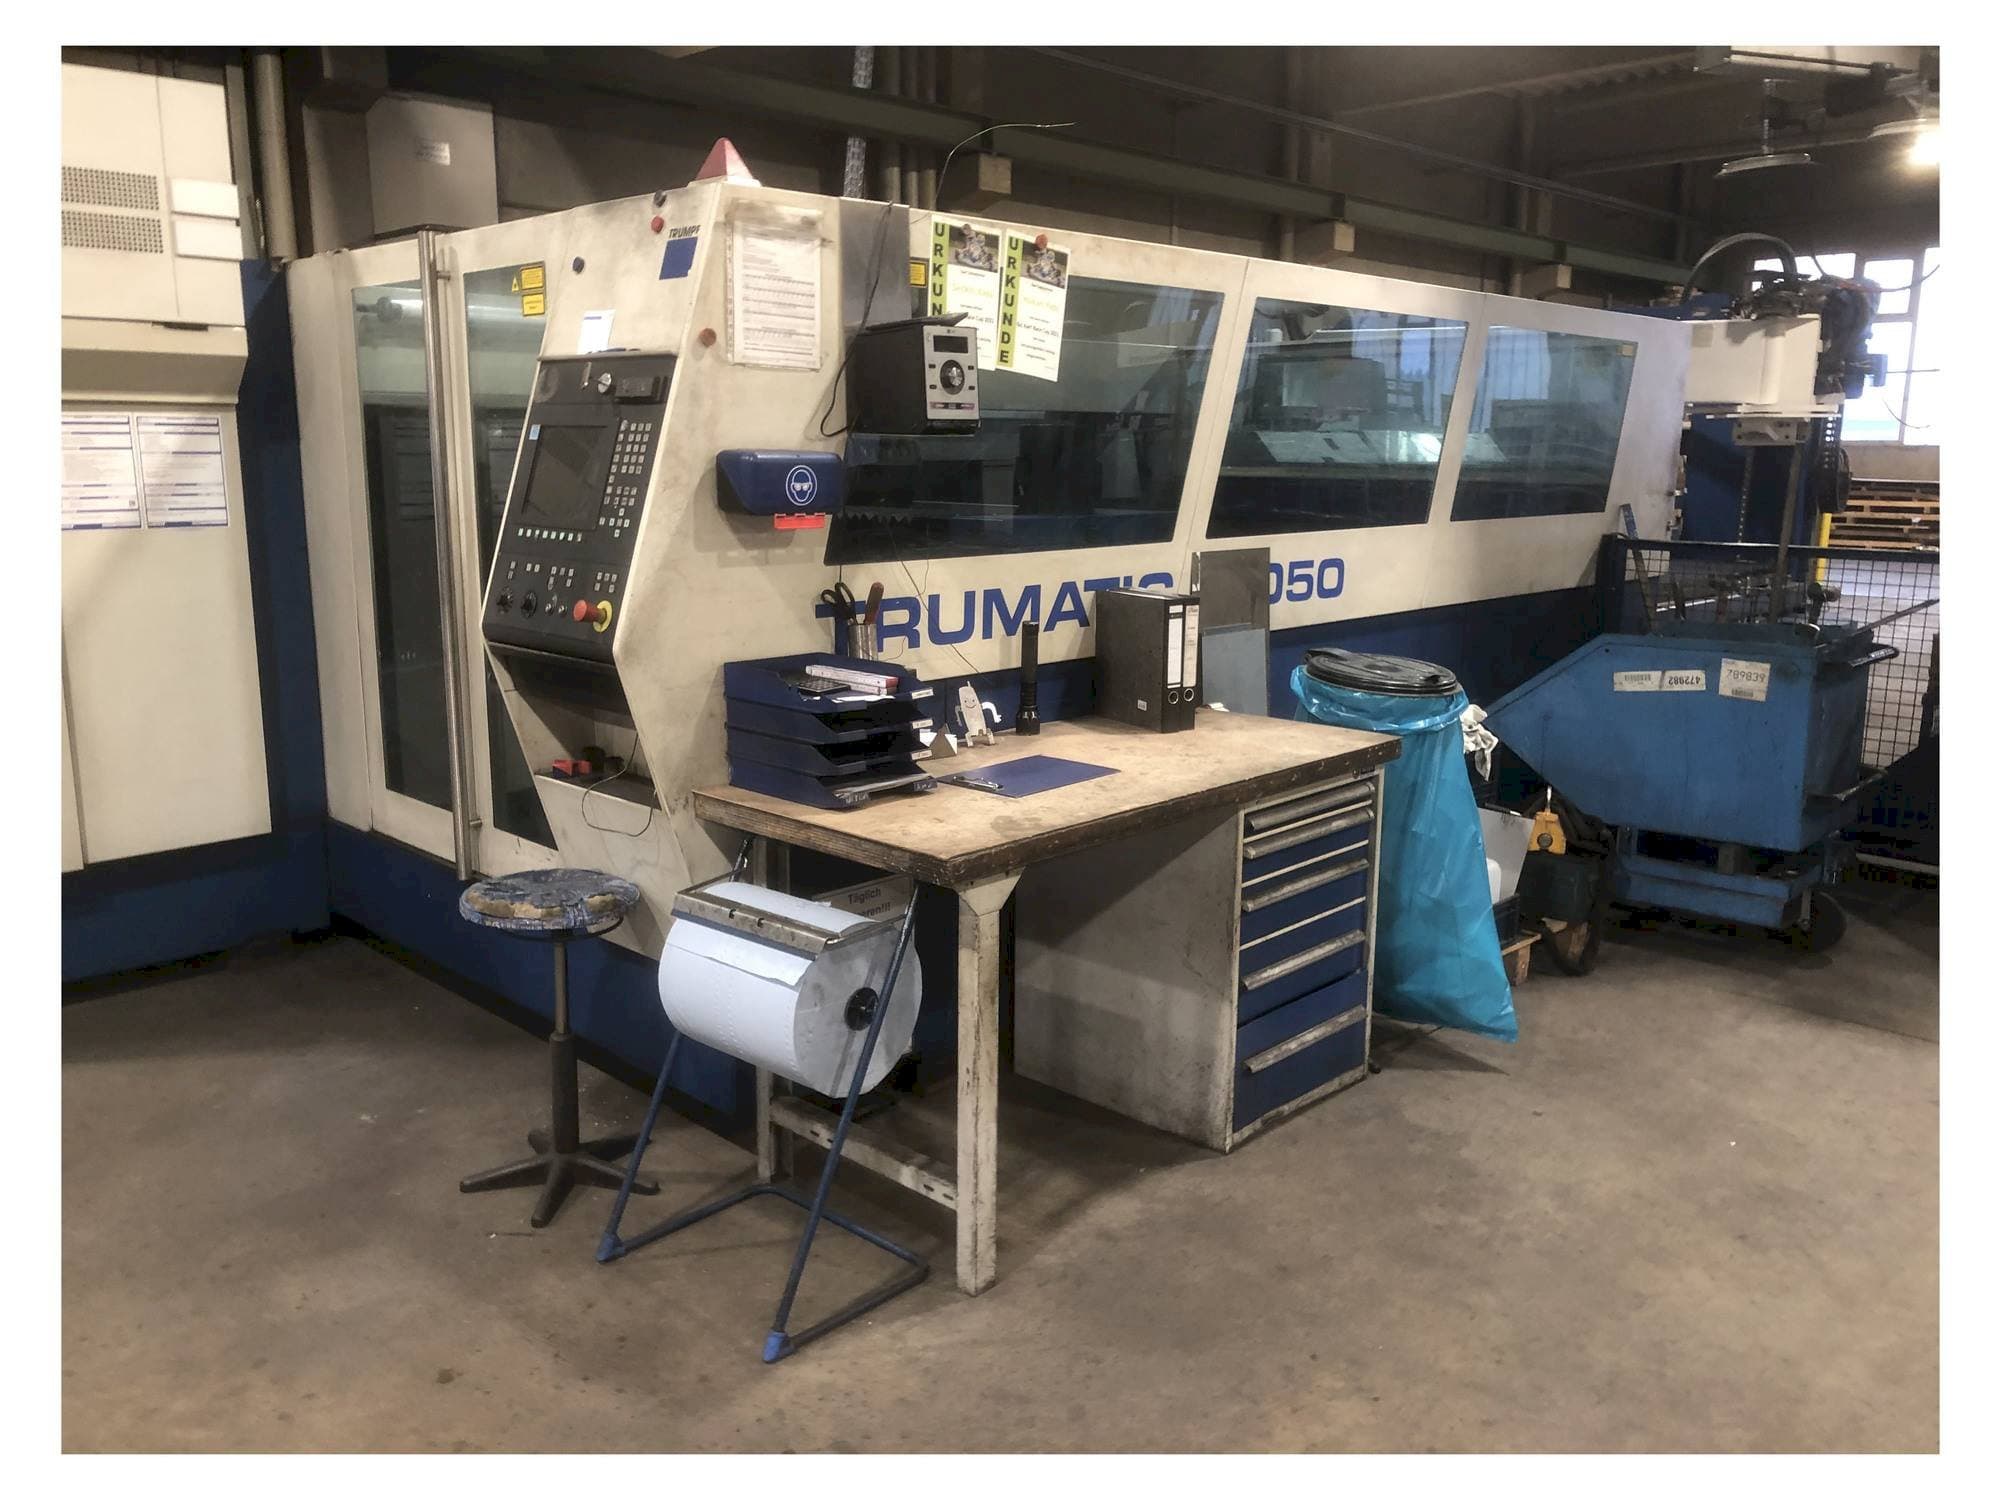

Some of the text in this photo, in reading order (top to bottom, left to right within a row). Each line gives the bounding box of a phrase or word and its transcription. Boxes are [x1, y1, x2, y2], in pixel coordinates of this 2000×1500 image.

[932, 223, 945, 316] URKUN
[1000, 238, 1019, 363] URKUNDE
[816, 572, 1173, 656] TRUMA
